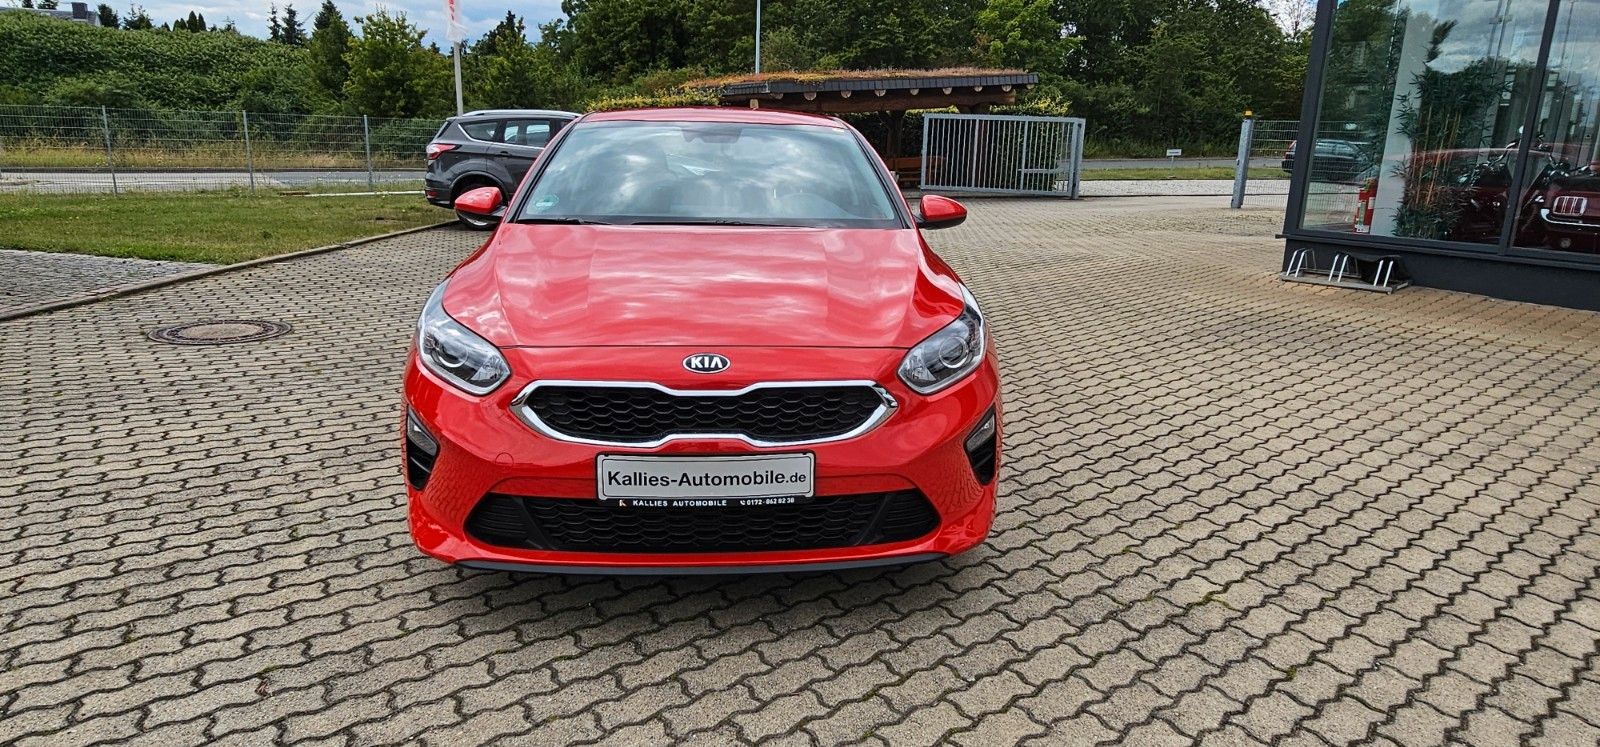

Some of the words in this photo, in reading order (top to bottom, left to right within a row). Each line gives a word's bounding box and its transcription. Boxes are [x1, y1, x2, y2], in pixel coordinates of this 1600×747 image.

[691, 356, 723, 369] KIA
[607, 470, 807, 487] Kallies-Automobile.de
[632, 499, 668, 507] KALLIES
[672, 499, 728, 507] AUTOMOBILE
